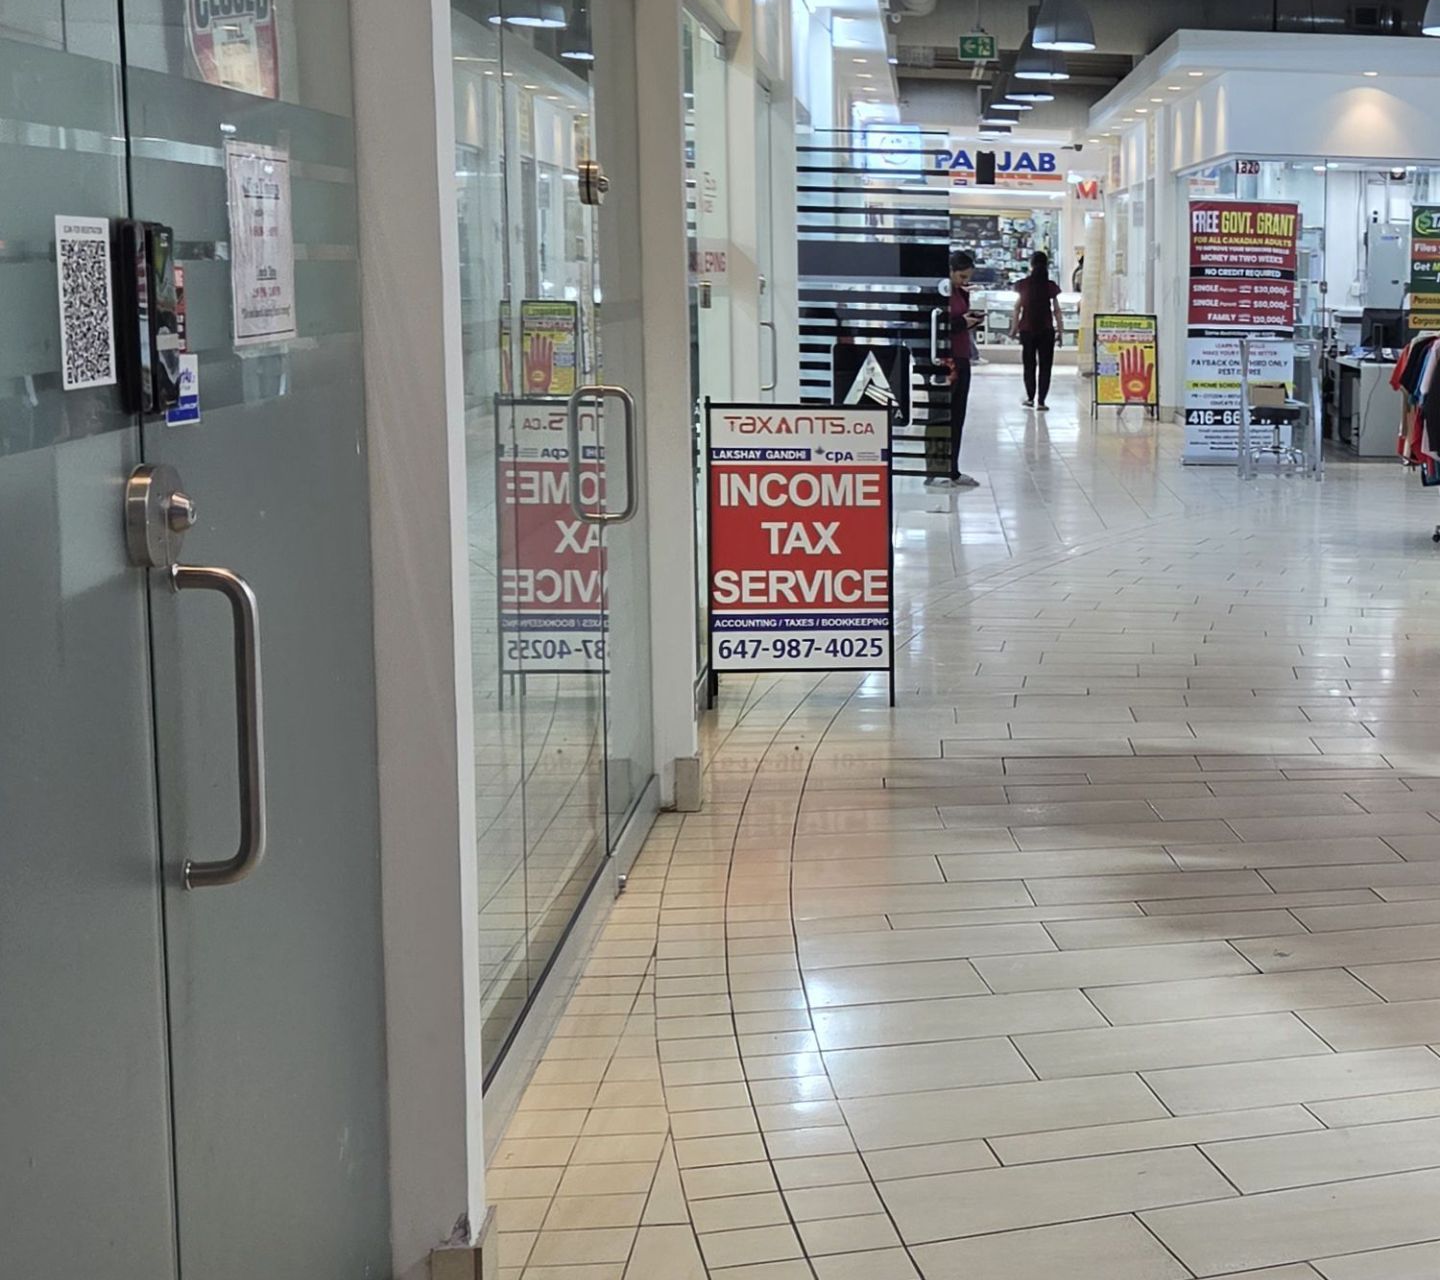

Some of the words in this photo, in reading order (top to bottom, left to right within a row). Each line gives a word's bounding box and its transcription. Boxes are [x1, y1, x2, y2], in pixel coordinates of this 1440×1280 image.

[934, 149, 1056, 173] PAJAB
[1192, 211, 1220, 233] FREE
[1221, 211, 1254, 234] GOVT.
[1257, 212, 1295, 236] GRANT
[1223, 237, 1263, 245] CANADIAN
[1264, 239, 1292, 247] ADULTS
[1414, 243, 1437, 252] Files
[1201, 254, 1229, 262] MONEY
[1240, 255, 1257, 263] TWO
[1258, 256, 1283, 264] WEEKS
[1414, 262, 1430, 271] Get
[1245, 269, 1281, 278] REQUIRED
[1207, 313, 1237, 321] FAMILY
[712, 449, 762, 461] LAKSHAY
[765, 449, 807, 461] GANDHI
[719, 472, 882, 508] INCOME
[761, 521, 841, 555] TAX
[712, 569, 889, 605] SERVICE
[714, 619, 777, 628] ACCOUNTING
[785, 618, 815, 627] TAXES
[821, 617, 889, 627] BOOKKEEPING
[718, 637, 883, 659] 647-987-4025
